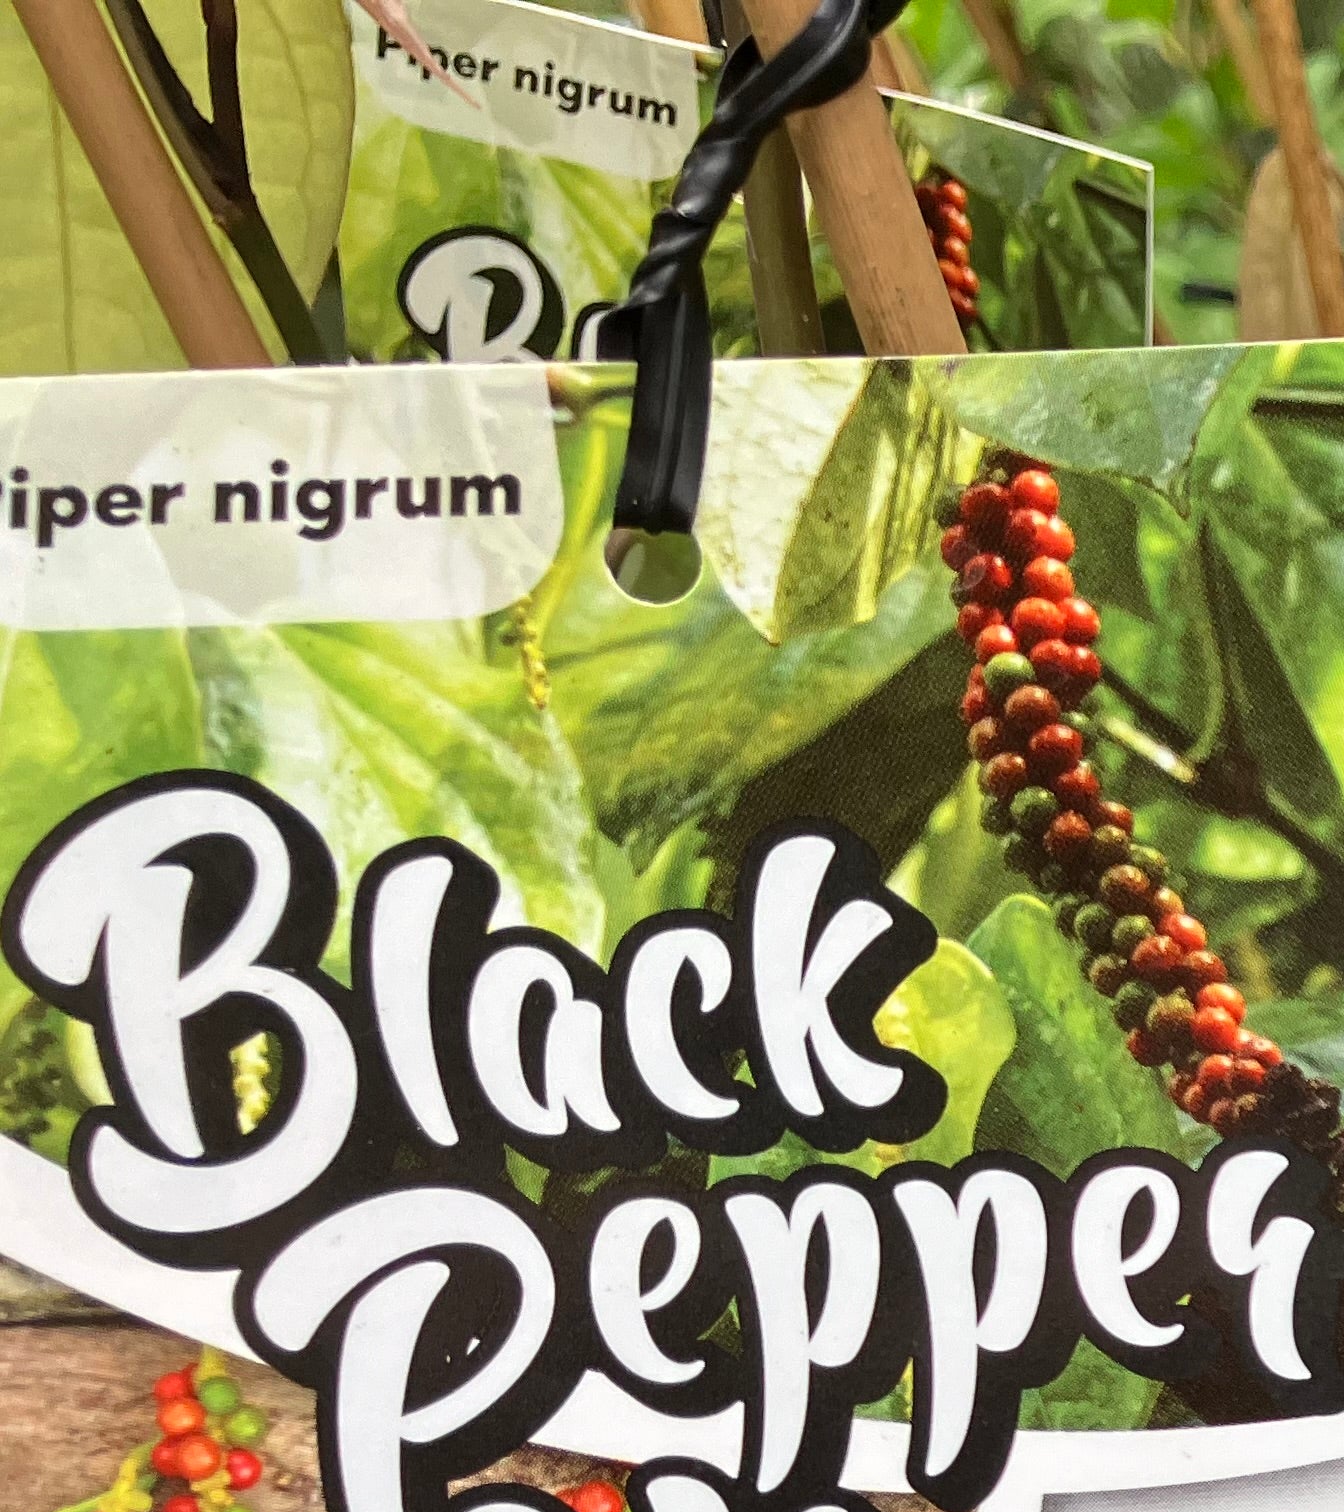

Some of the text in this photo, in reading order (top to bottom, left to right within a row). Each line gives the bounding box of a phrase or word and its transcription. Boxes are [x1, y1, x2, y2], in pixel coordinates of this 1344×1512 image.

[514, 62, 678, 127] nigrum
[0, 458, 522, 548] iper nigrum
[16, 780, 908, 1232] Black
